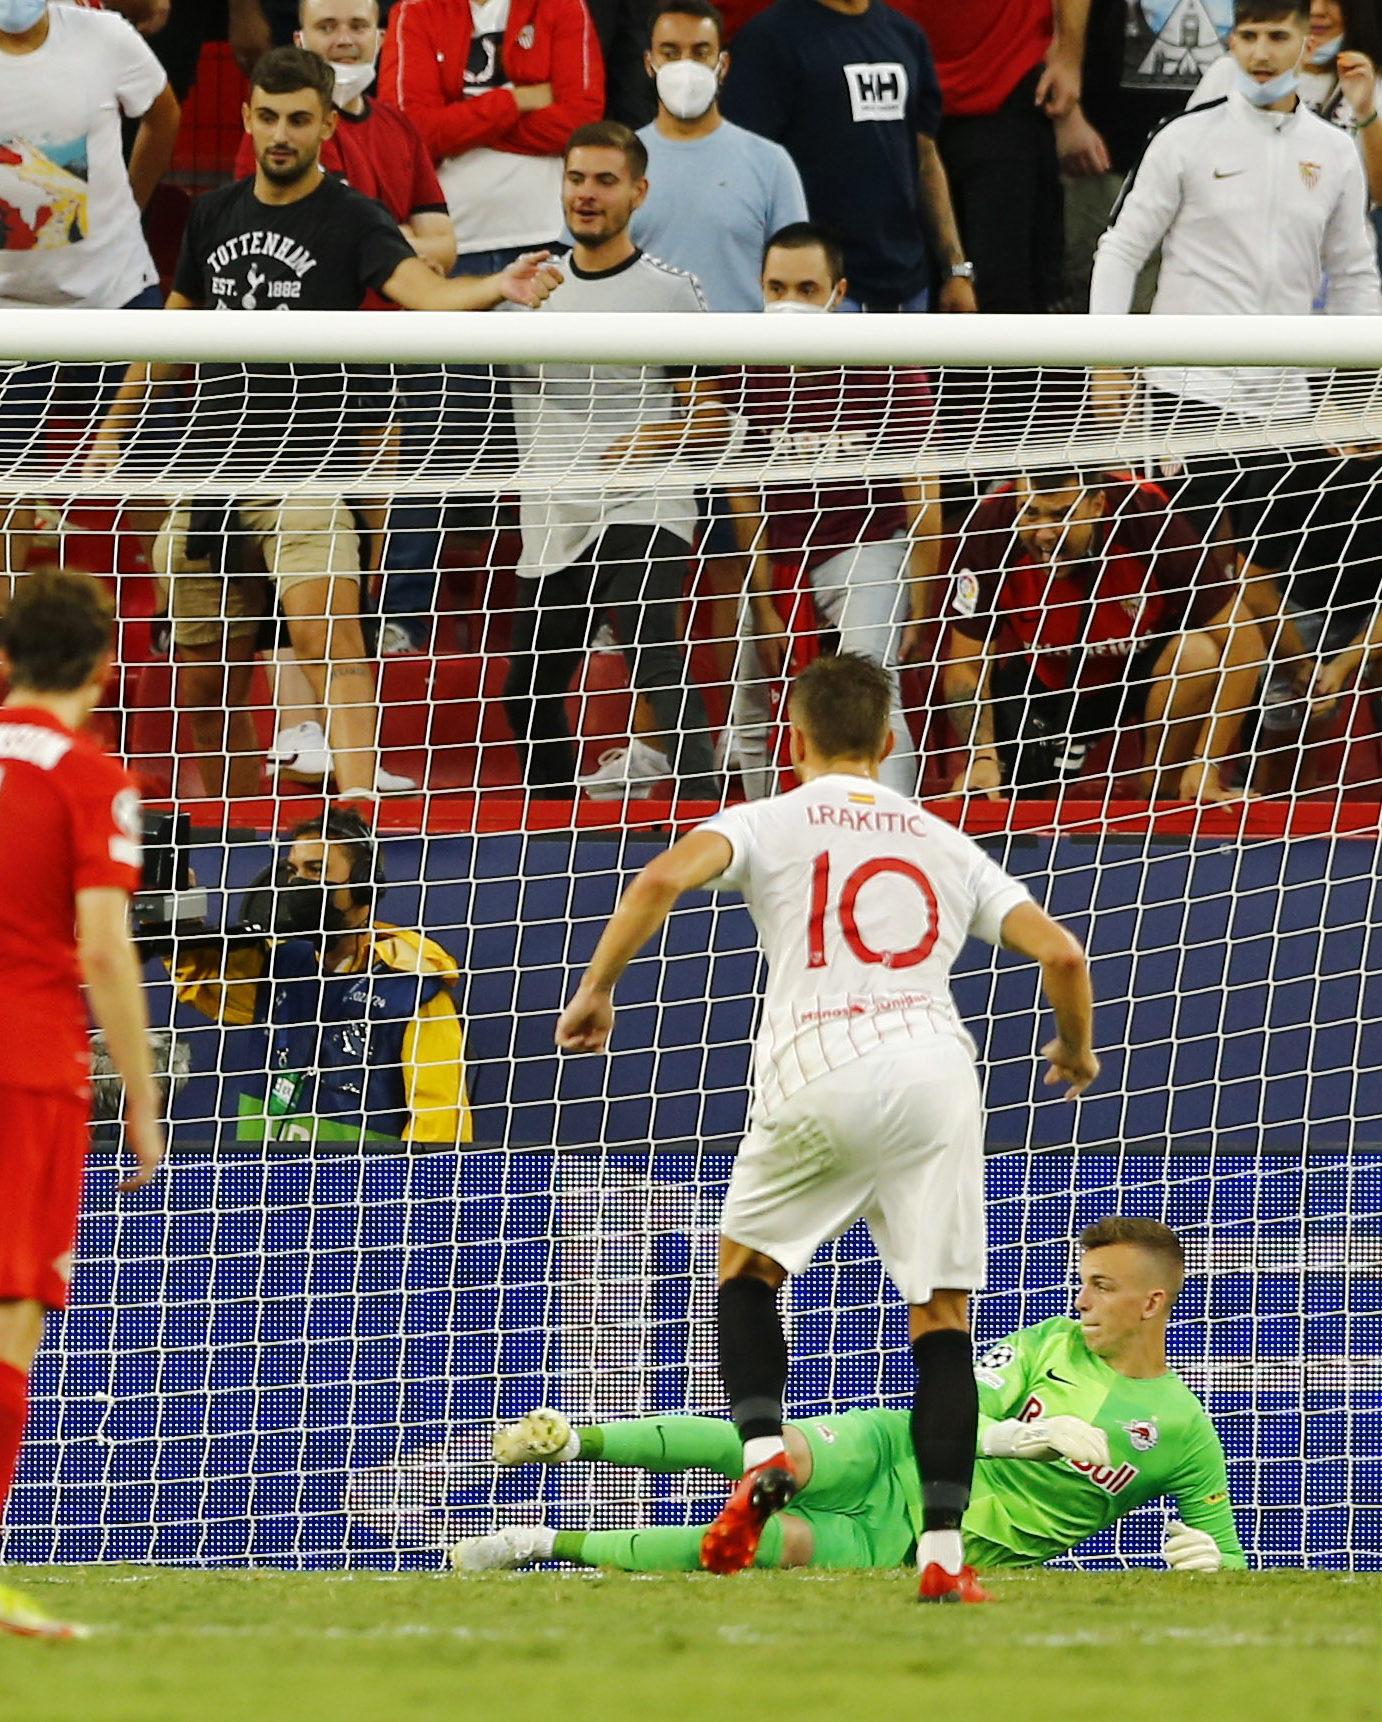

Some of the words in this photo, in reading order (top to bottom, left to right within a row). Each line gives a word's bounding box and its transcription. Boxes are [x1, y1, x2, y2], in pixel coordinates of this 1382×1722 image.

[856, 72, 899, 102] HH
[206, 230, 317, 278] TOTTENHAM
[211, 276, 238, 296] EST.
[267, 280, 302, 298] 1882
[806, 805, 927, 838] I.RAKITIC
[806, 850, 939, 970] 10
